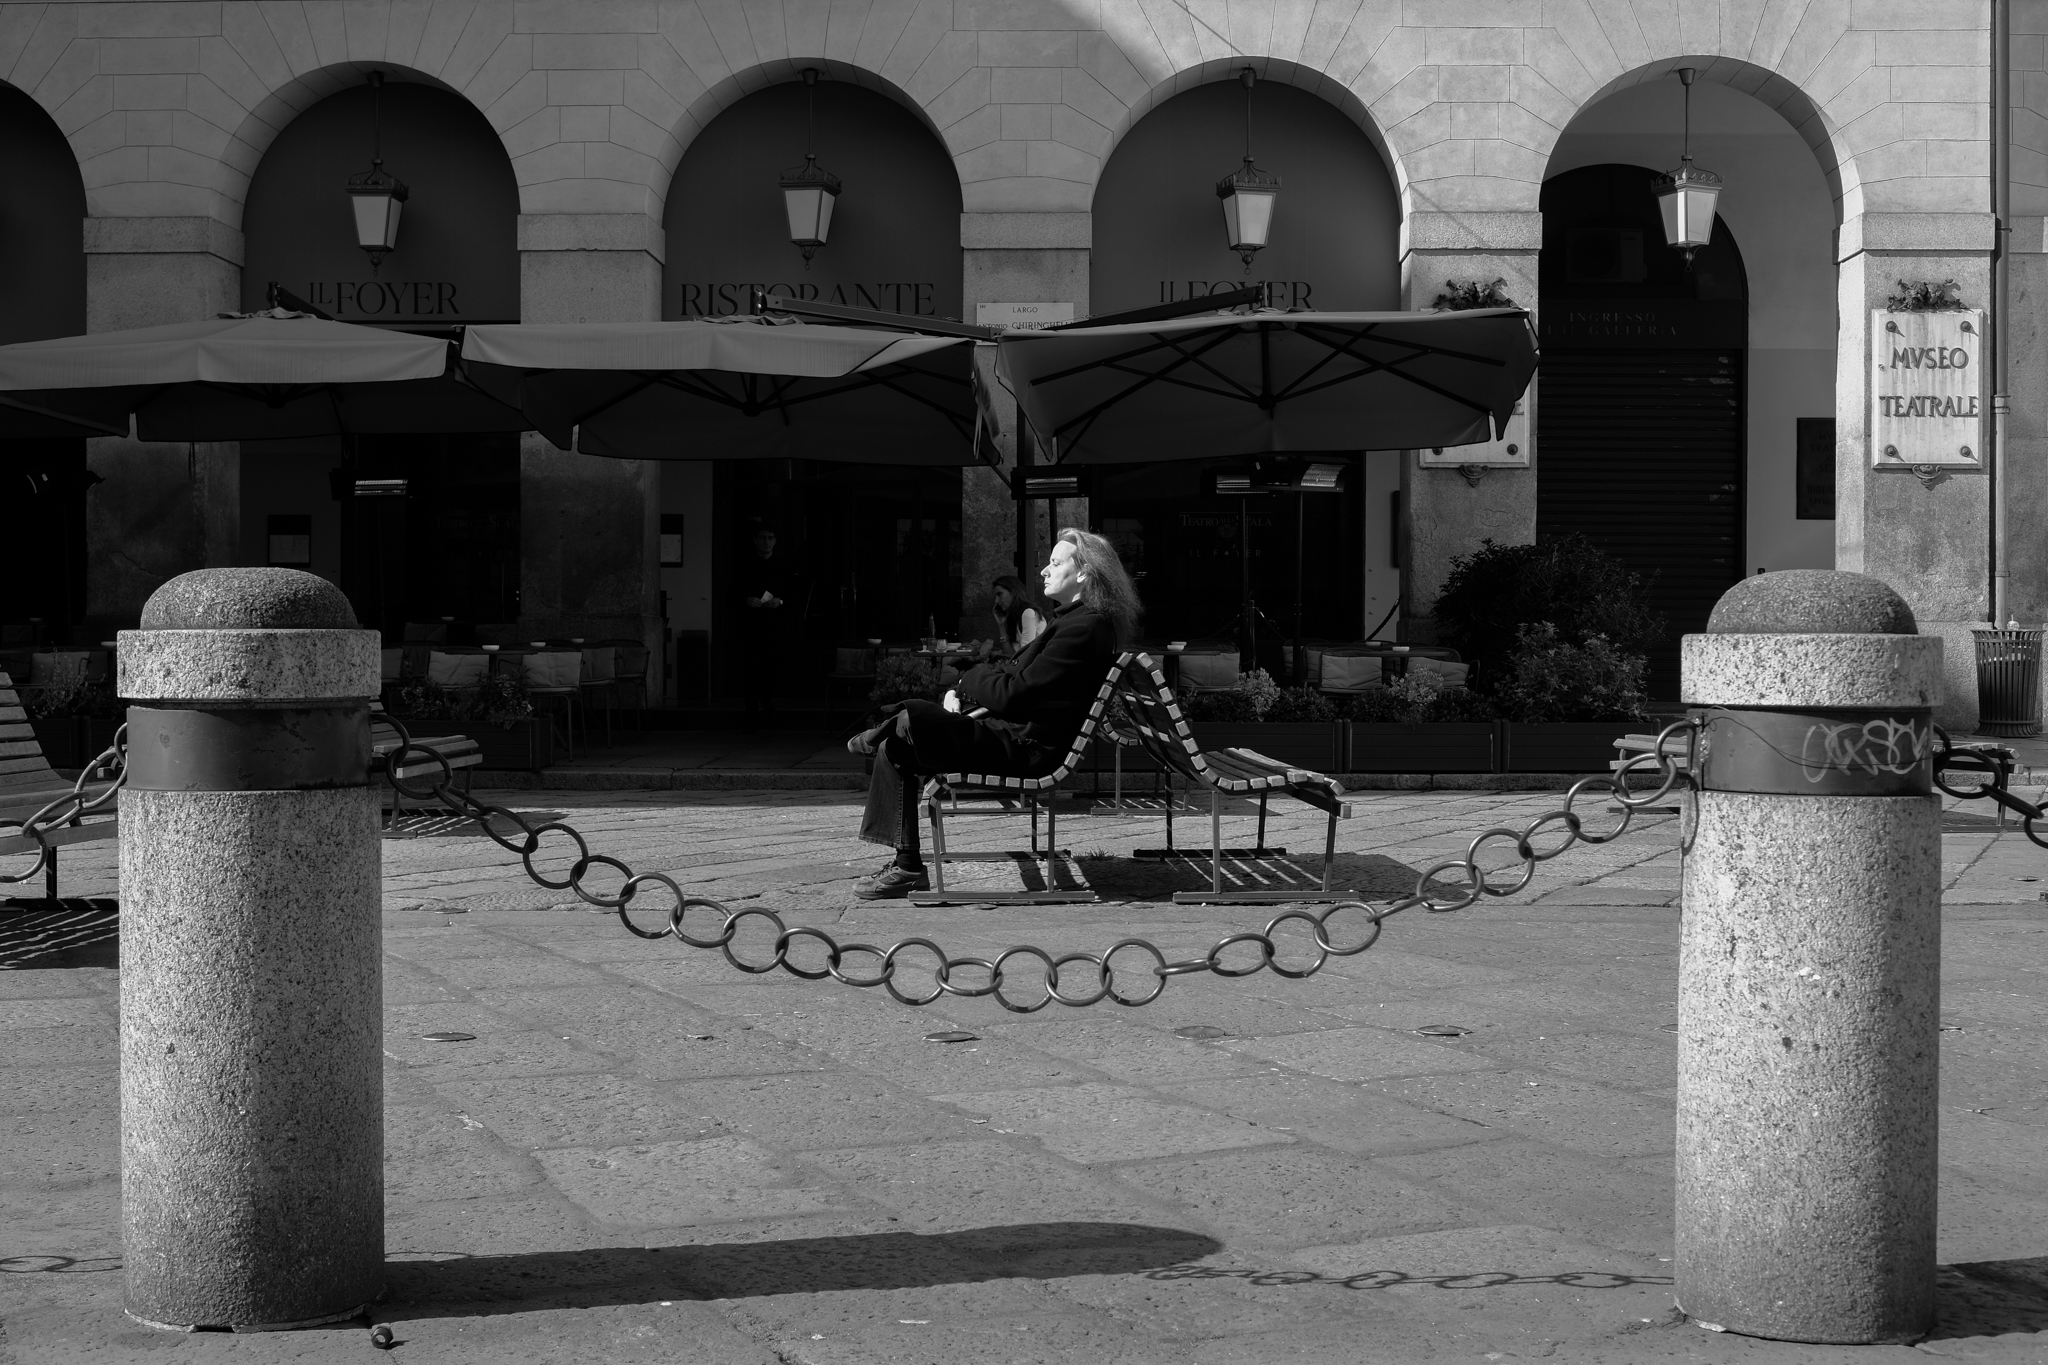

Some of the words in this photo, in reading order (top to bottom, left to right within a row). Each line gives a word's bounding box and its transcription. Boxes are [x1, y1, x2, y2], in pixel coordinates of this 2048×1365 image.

[309, 282, 333, 304] IL
[336, 281, 460, 315] FOYER
[680, 283, 935, 316] RISTORANTE
[1160, 281, 1183, 303] IL
[1569, 312, 1655, 322] INGRESSO
[1589, 325, 1677, 335] GALLERIA
[1890, 346, 1969, 369] MVSEO
[1879, 395, 1979, 418] TEATRALE
